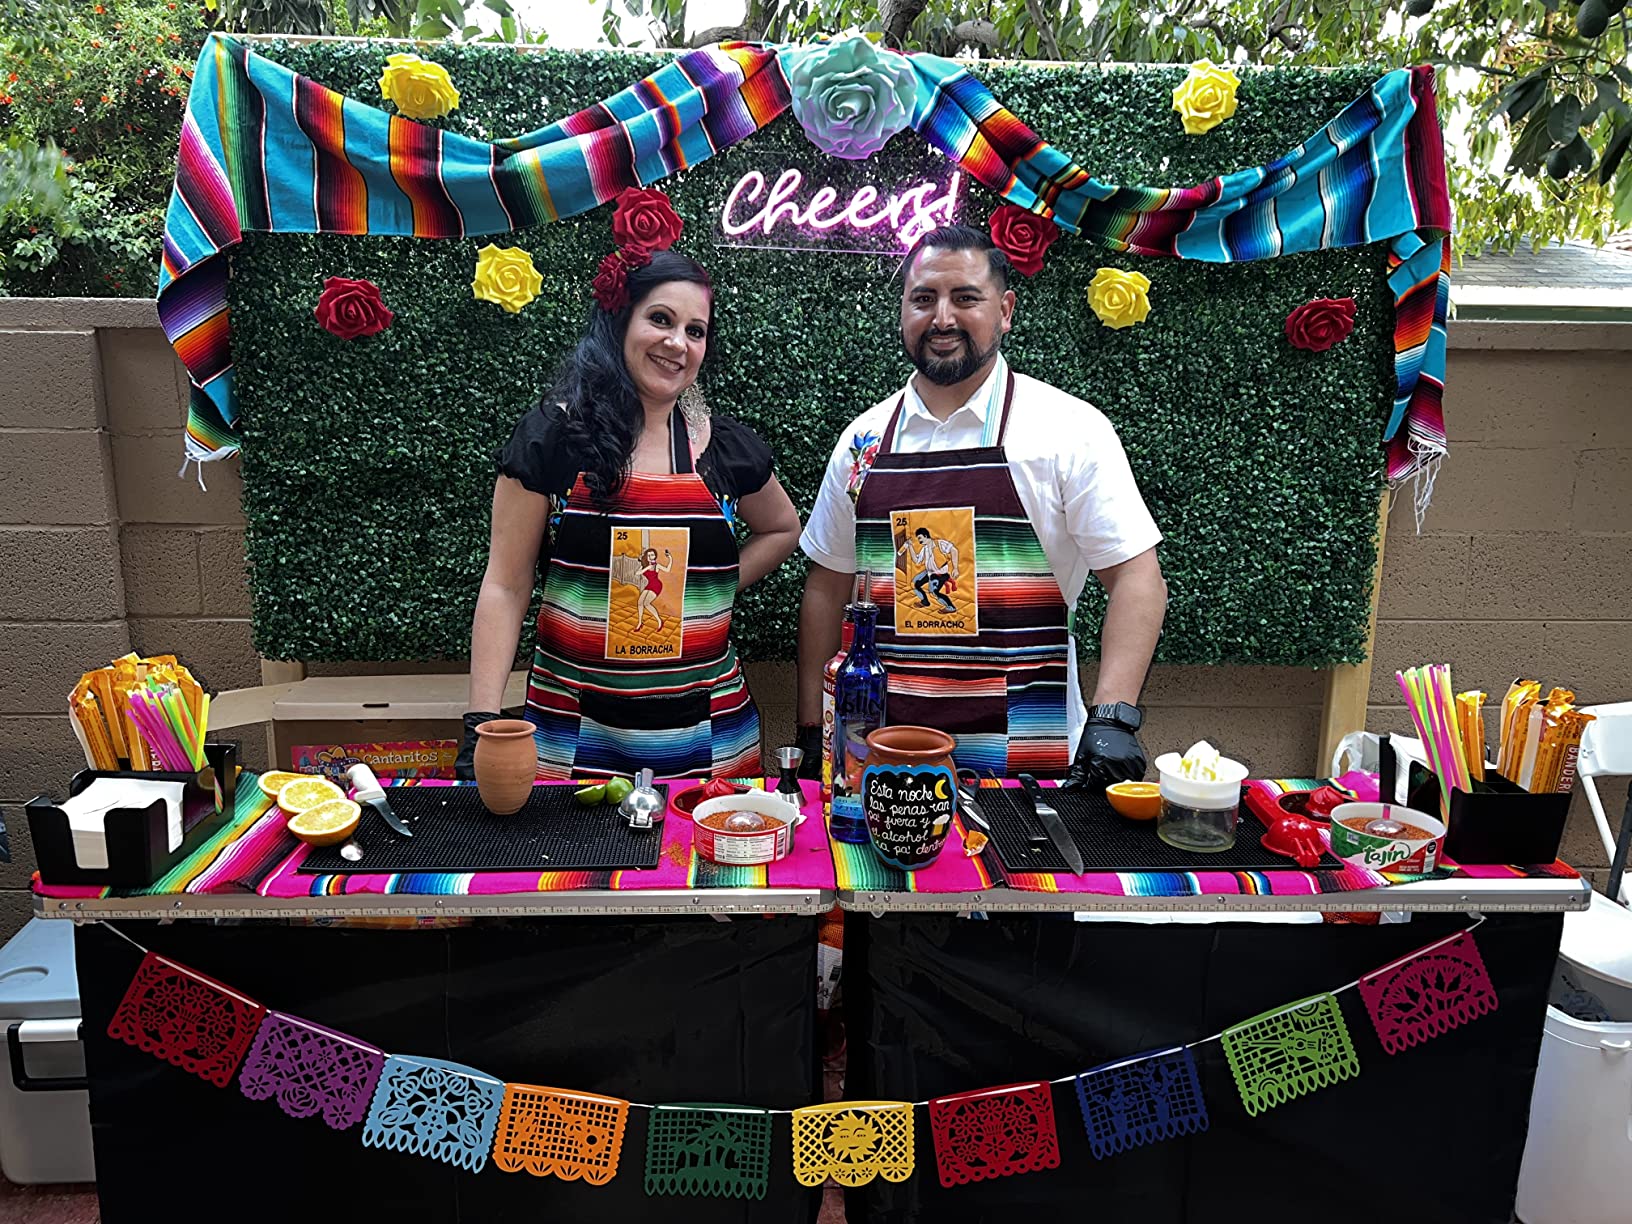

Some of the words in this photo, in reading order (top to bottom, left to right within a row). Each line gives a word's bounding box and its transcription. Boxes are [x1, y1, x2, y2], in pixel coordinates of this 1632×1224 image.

[896, 518, 907, 526] 25
[617, 531, 628, 540] 25
[905, 620, 914, 628] EL
[917, 620, 965, 628] BORRACHO
[615, 645, 626, 654] LA
[629, 644, 674, 655] BORRACHA
[363, 751, 438, 767] Cantaritos
[870, 778, 893, 799] Esta
[898, 784, 934, 801] noche
[869, 796, 886, 812] las
[889, 804, 929, 816] penas
[920, 817, 930, 829] y
[881, 829, 928, 842] alcohol
